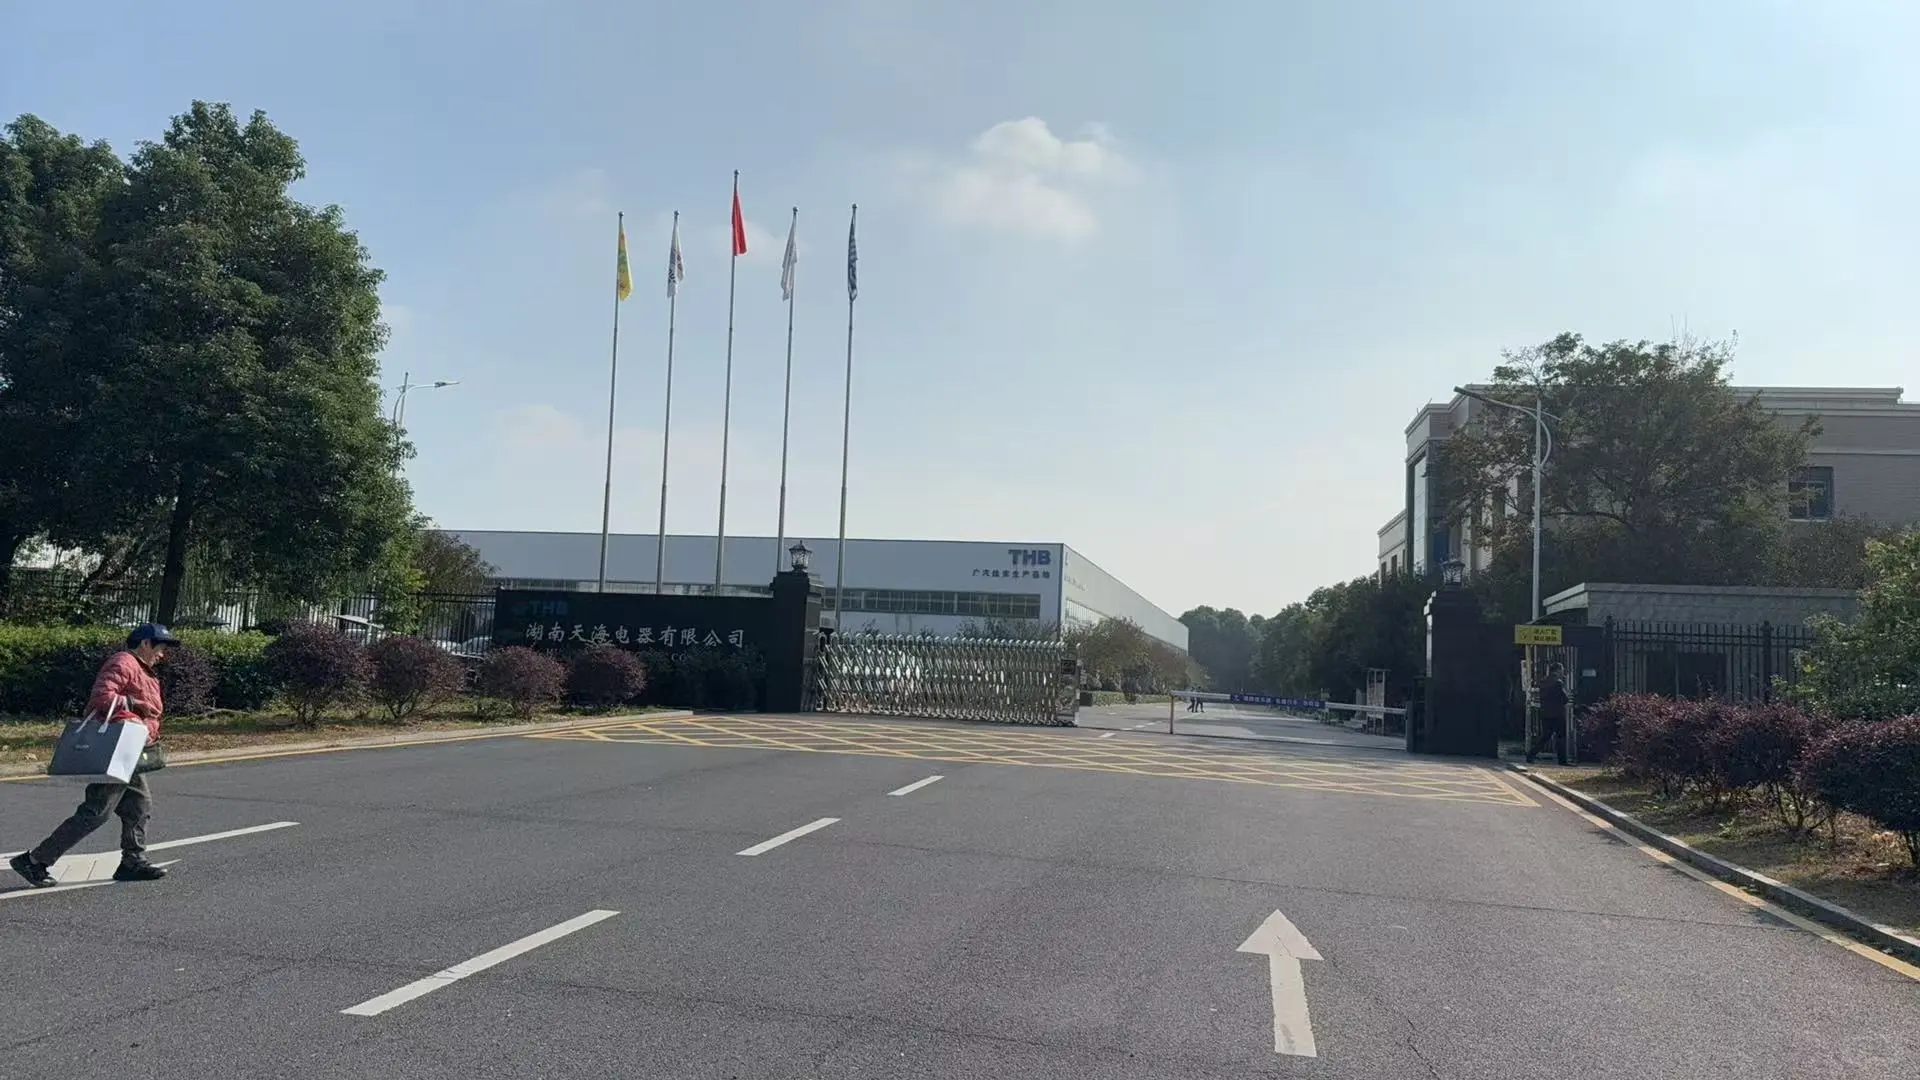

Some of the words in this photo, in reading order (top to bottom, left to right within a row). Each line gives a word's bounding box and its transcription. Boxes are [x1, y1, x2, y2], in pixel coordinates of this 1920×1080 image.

[1008, 549, 1051, 566] THB
[529, 600, 568, 616] THB
[525, 621, 744, 648] 湖南天海电器有限公司
